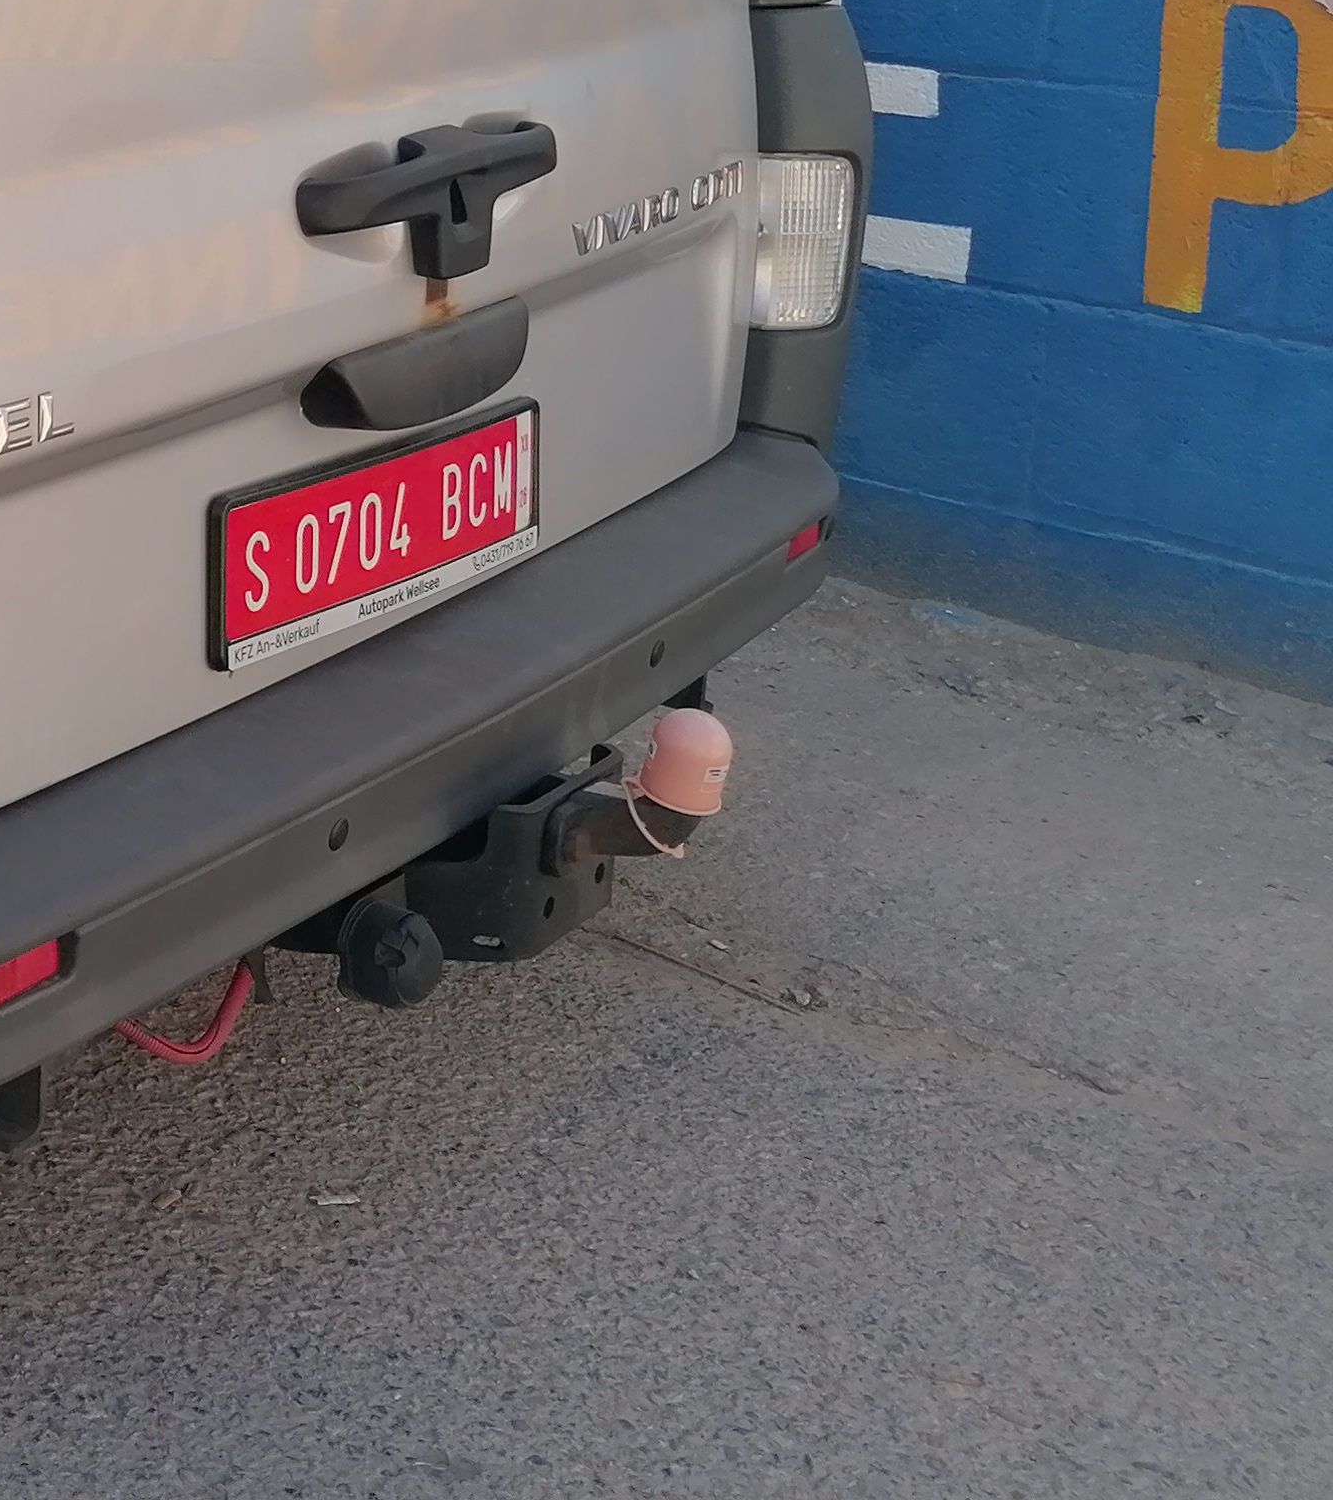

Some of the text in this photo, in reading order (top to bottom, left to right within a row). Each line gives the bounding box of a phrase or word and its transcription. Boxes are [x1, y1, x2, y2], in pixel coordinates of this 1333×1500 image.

[571, 159, 744, 256] VIVARO CDTI
[244, 441, 513, 612] S 0704 BCM
[358, 577, 440, 619] Autopark Wellsee
[234, 643, 254, 663] KFZ
